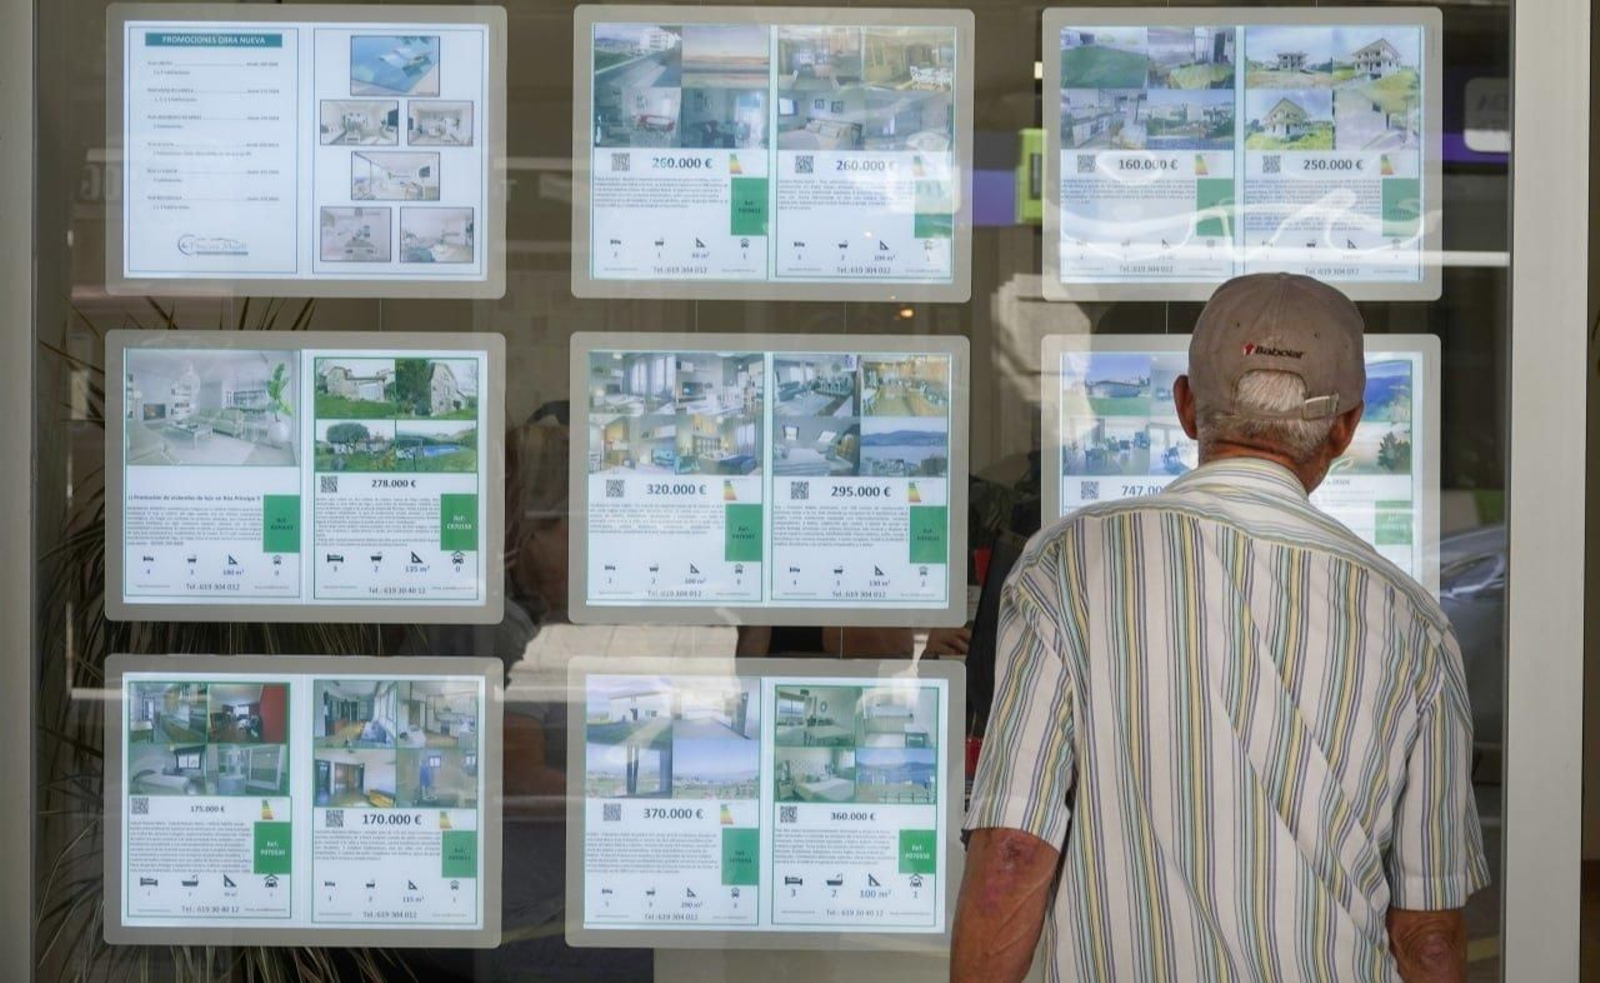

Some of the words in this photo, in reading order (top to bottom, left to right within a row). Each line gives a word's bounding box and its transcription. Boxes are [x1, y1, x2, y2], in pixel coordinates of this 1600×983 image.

[162, 36, 217, 44] PROMOCIONES
[218, 36, 238, 44] OBRA
[240, 36, 266, 44] NUEVA
[652, 158, 701, 169] 260.000
[705, 158, 713, 169] €
[836, 160, 886, 171] 260.000
[1119, 159, 1168, 170] 160.000
[1171, 159, 1178, 170] €
[1303, 159, 1352, 170] 250.000
[1356, 159, 1364, 170] €
[371, 479, 408, 488] 278.000
[410, 479, 416, 488] €
[647, 484, 696, 495] 320.000
[699, 484, 707, 495] €
[831, 486, 880, 497] 295.000
[884, 486, 891, 497] €
[1122, 485, 1163, 496] 747.00
[191, 805, 219, 813] 175.000
[643, 808, 692, 819] 370.000
[696, 808, 704, 819] €
[362, 814, 411, 825] 170.000
[414, 814, 422, 825] €
[831, 812, 868, 821] 360.000
[870, 812, 876, 821] €
